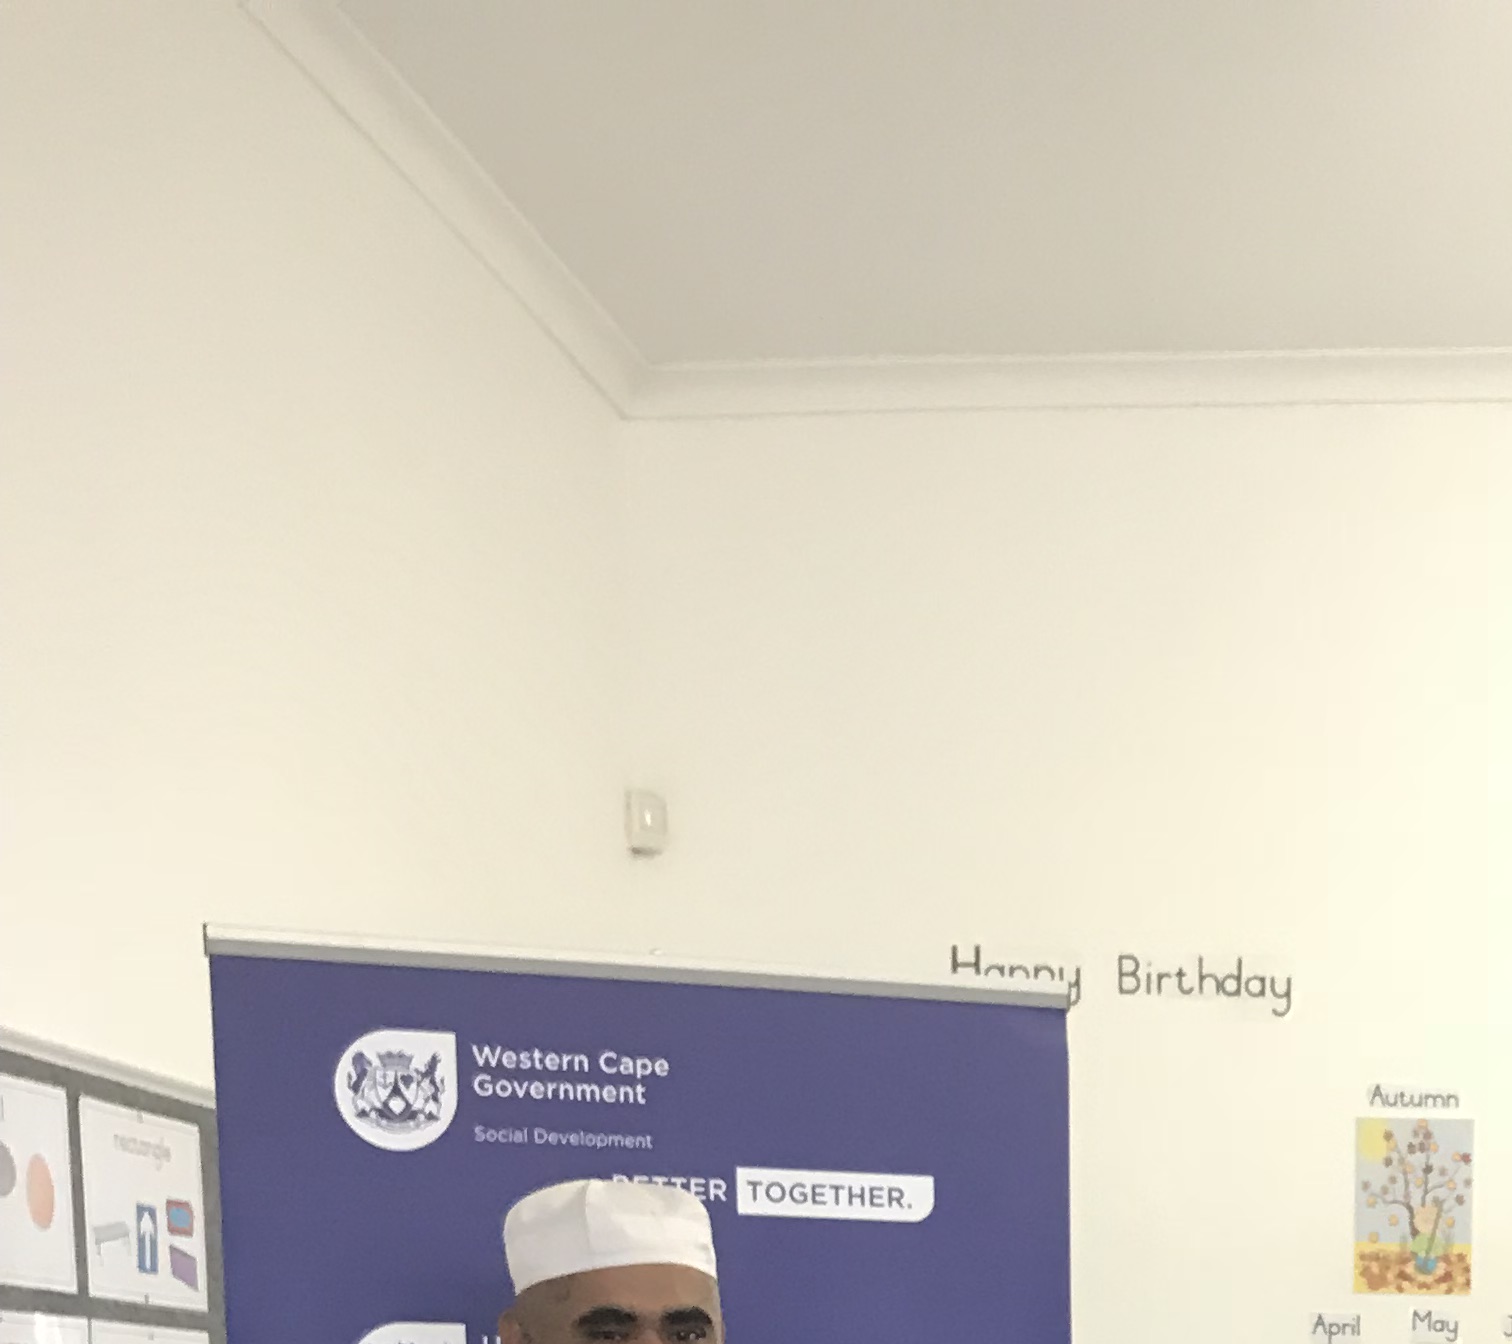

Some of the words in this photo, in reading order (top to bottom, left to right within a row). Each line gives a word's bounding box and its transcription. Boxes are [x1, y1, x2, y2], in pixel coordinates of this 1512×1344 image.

[1117, 953, 1293, 1017] Birthday
[472, 1044, 590, 1073] Western
[599, 1050, 670, 1079] Cape
[473, 1073, 647, 1105] Government
[1369, 1083, 1460, 1108] Autumn
[473, 1124, 529, 1143] Social
[534, 1127, 653, 1150] Development
[747, 1180, 914, 1210] TOGETHER.
[1311, 1314, 1361, 1344] April
[1411, 1309, 1460, 1343] May
